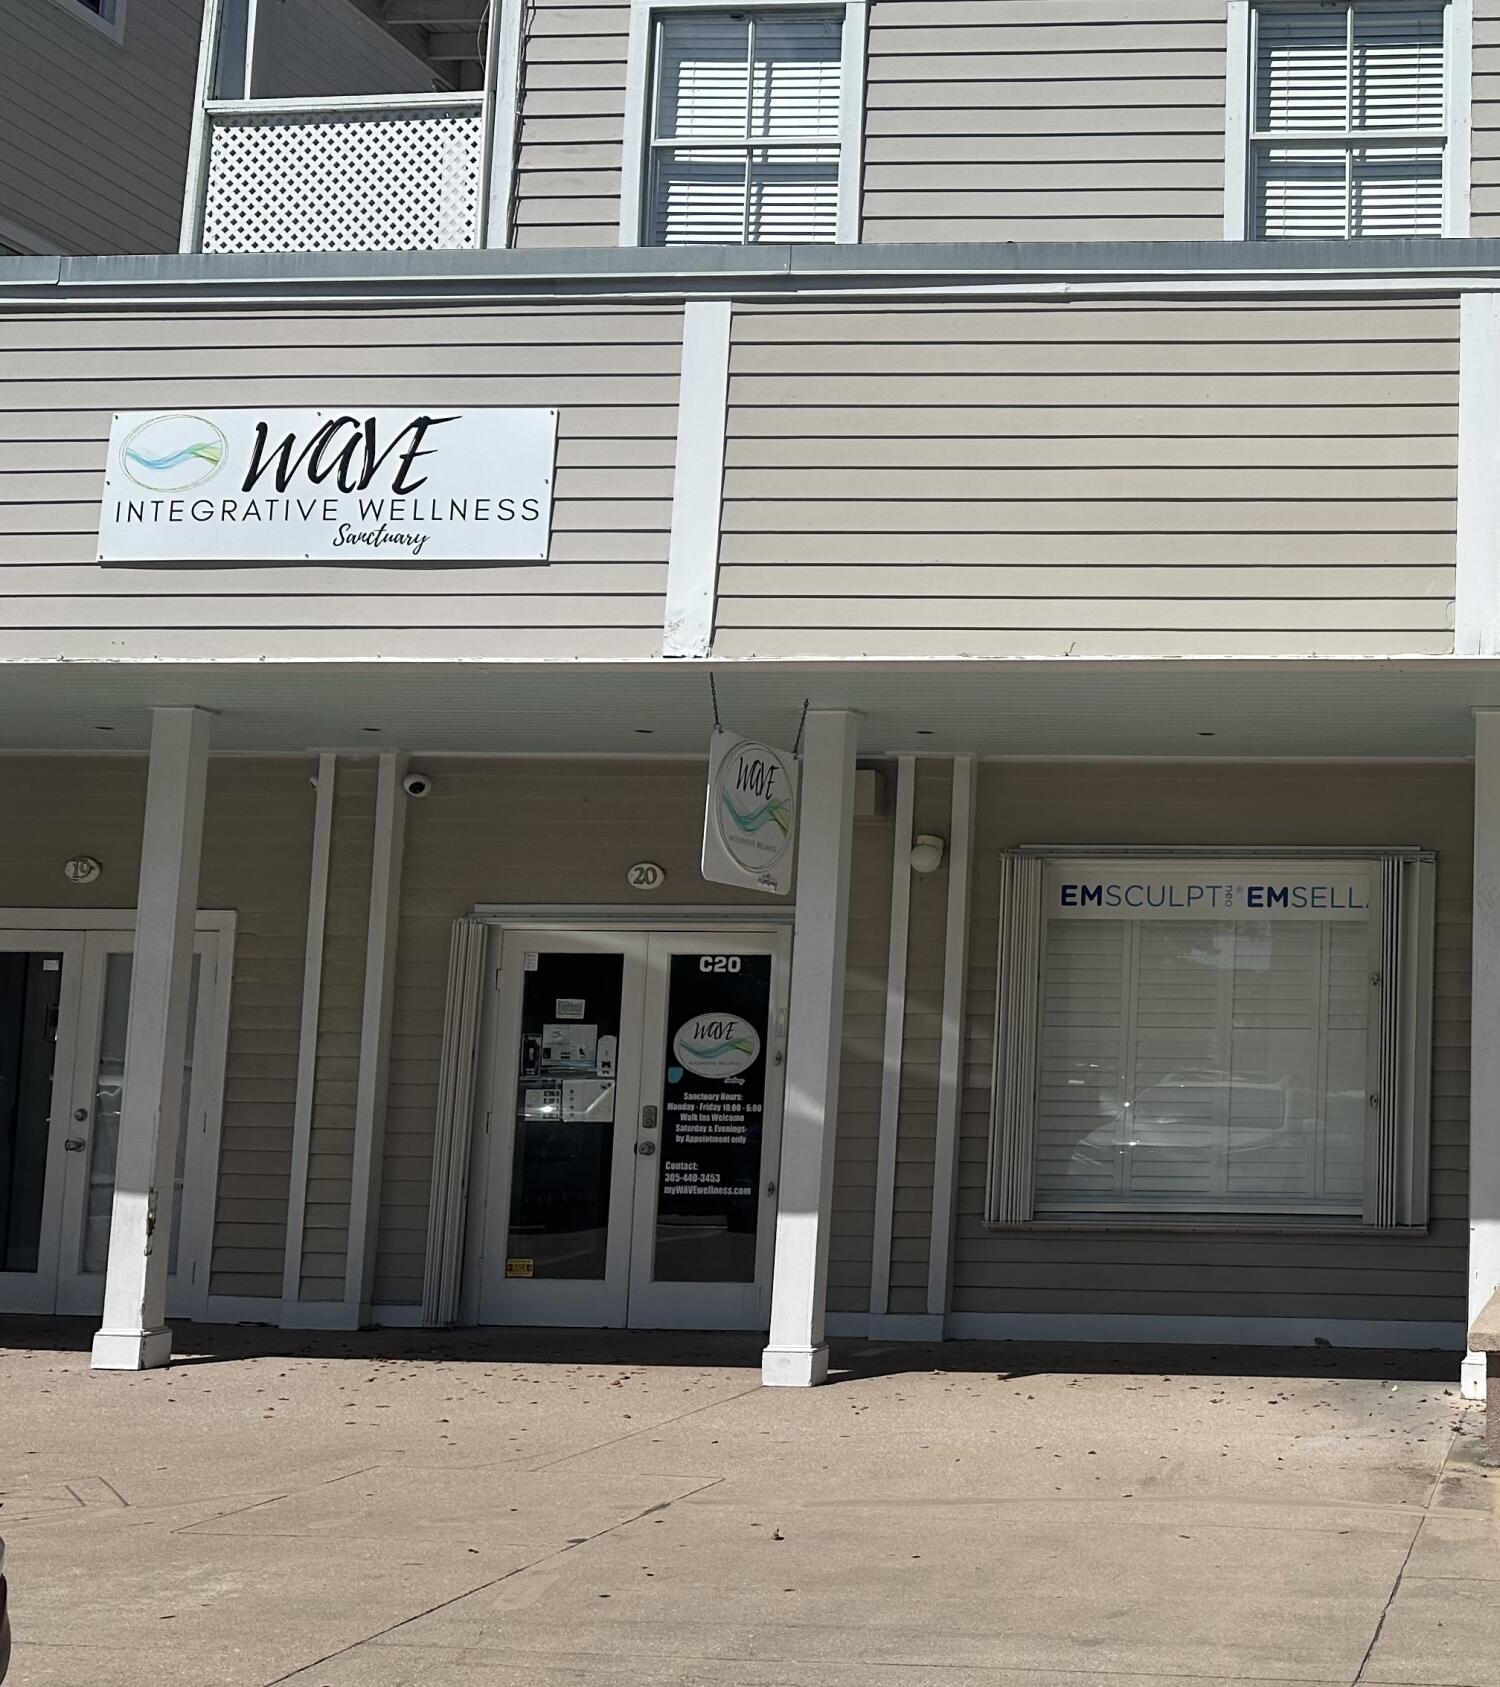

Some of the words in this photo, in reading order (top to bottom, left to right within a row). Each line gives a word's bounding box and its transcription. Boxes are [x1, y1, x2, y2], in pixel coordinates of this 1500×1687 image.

[115, 499, 339, 523] INTEGRATIVE
[358, 498, 540, 521] WELLNESS
[332, 522, 430, 555] Sanctuary
[633, 866, 657, 885] 20
[1061, 884, 1223, 907] EMSCULPT
[1247, 886, 1369, 909] EMSELL
[699, 956, 741, 973] C20
[683, 1092, 720, 1101] Sanctuary
[667, 1103, 695, 1112] Monday
[700, 1103, 721, 1112] Friday
[680, 1113, 698, 1121] Walk
[711, 1114, 744, 1122] Welcome
[675, 1124, 707, 1133] Saturday
[675, 1135, 684, 1144] by
[685, 1135, 730, 1144] Appointment
[731, 1136, 746, 1144] only
[665, 1161, 698, 1170] Contact:
[664, 1173, 720, 1182] 305-440-3453
[664, 1185, 751, 1195] myWAVEwellness.com
